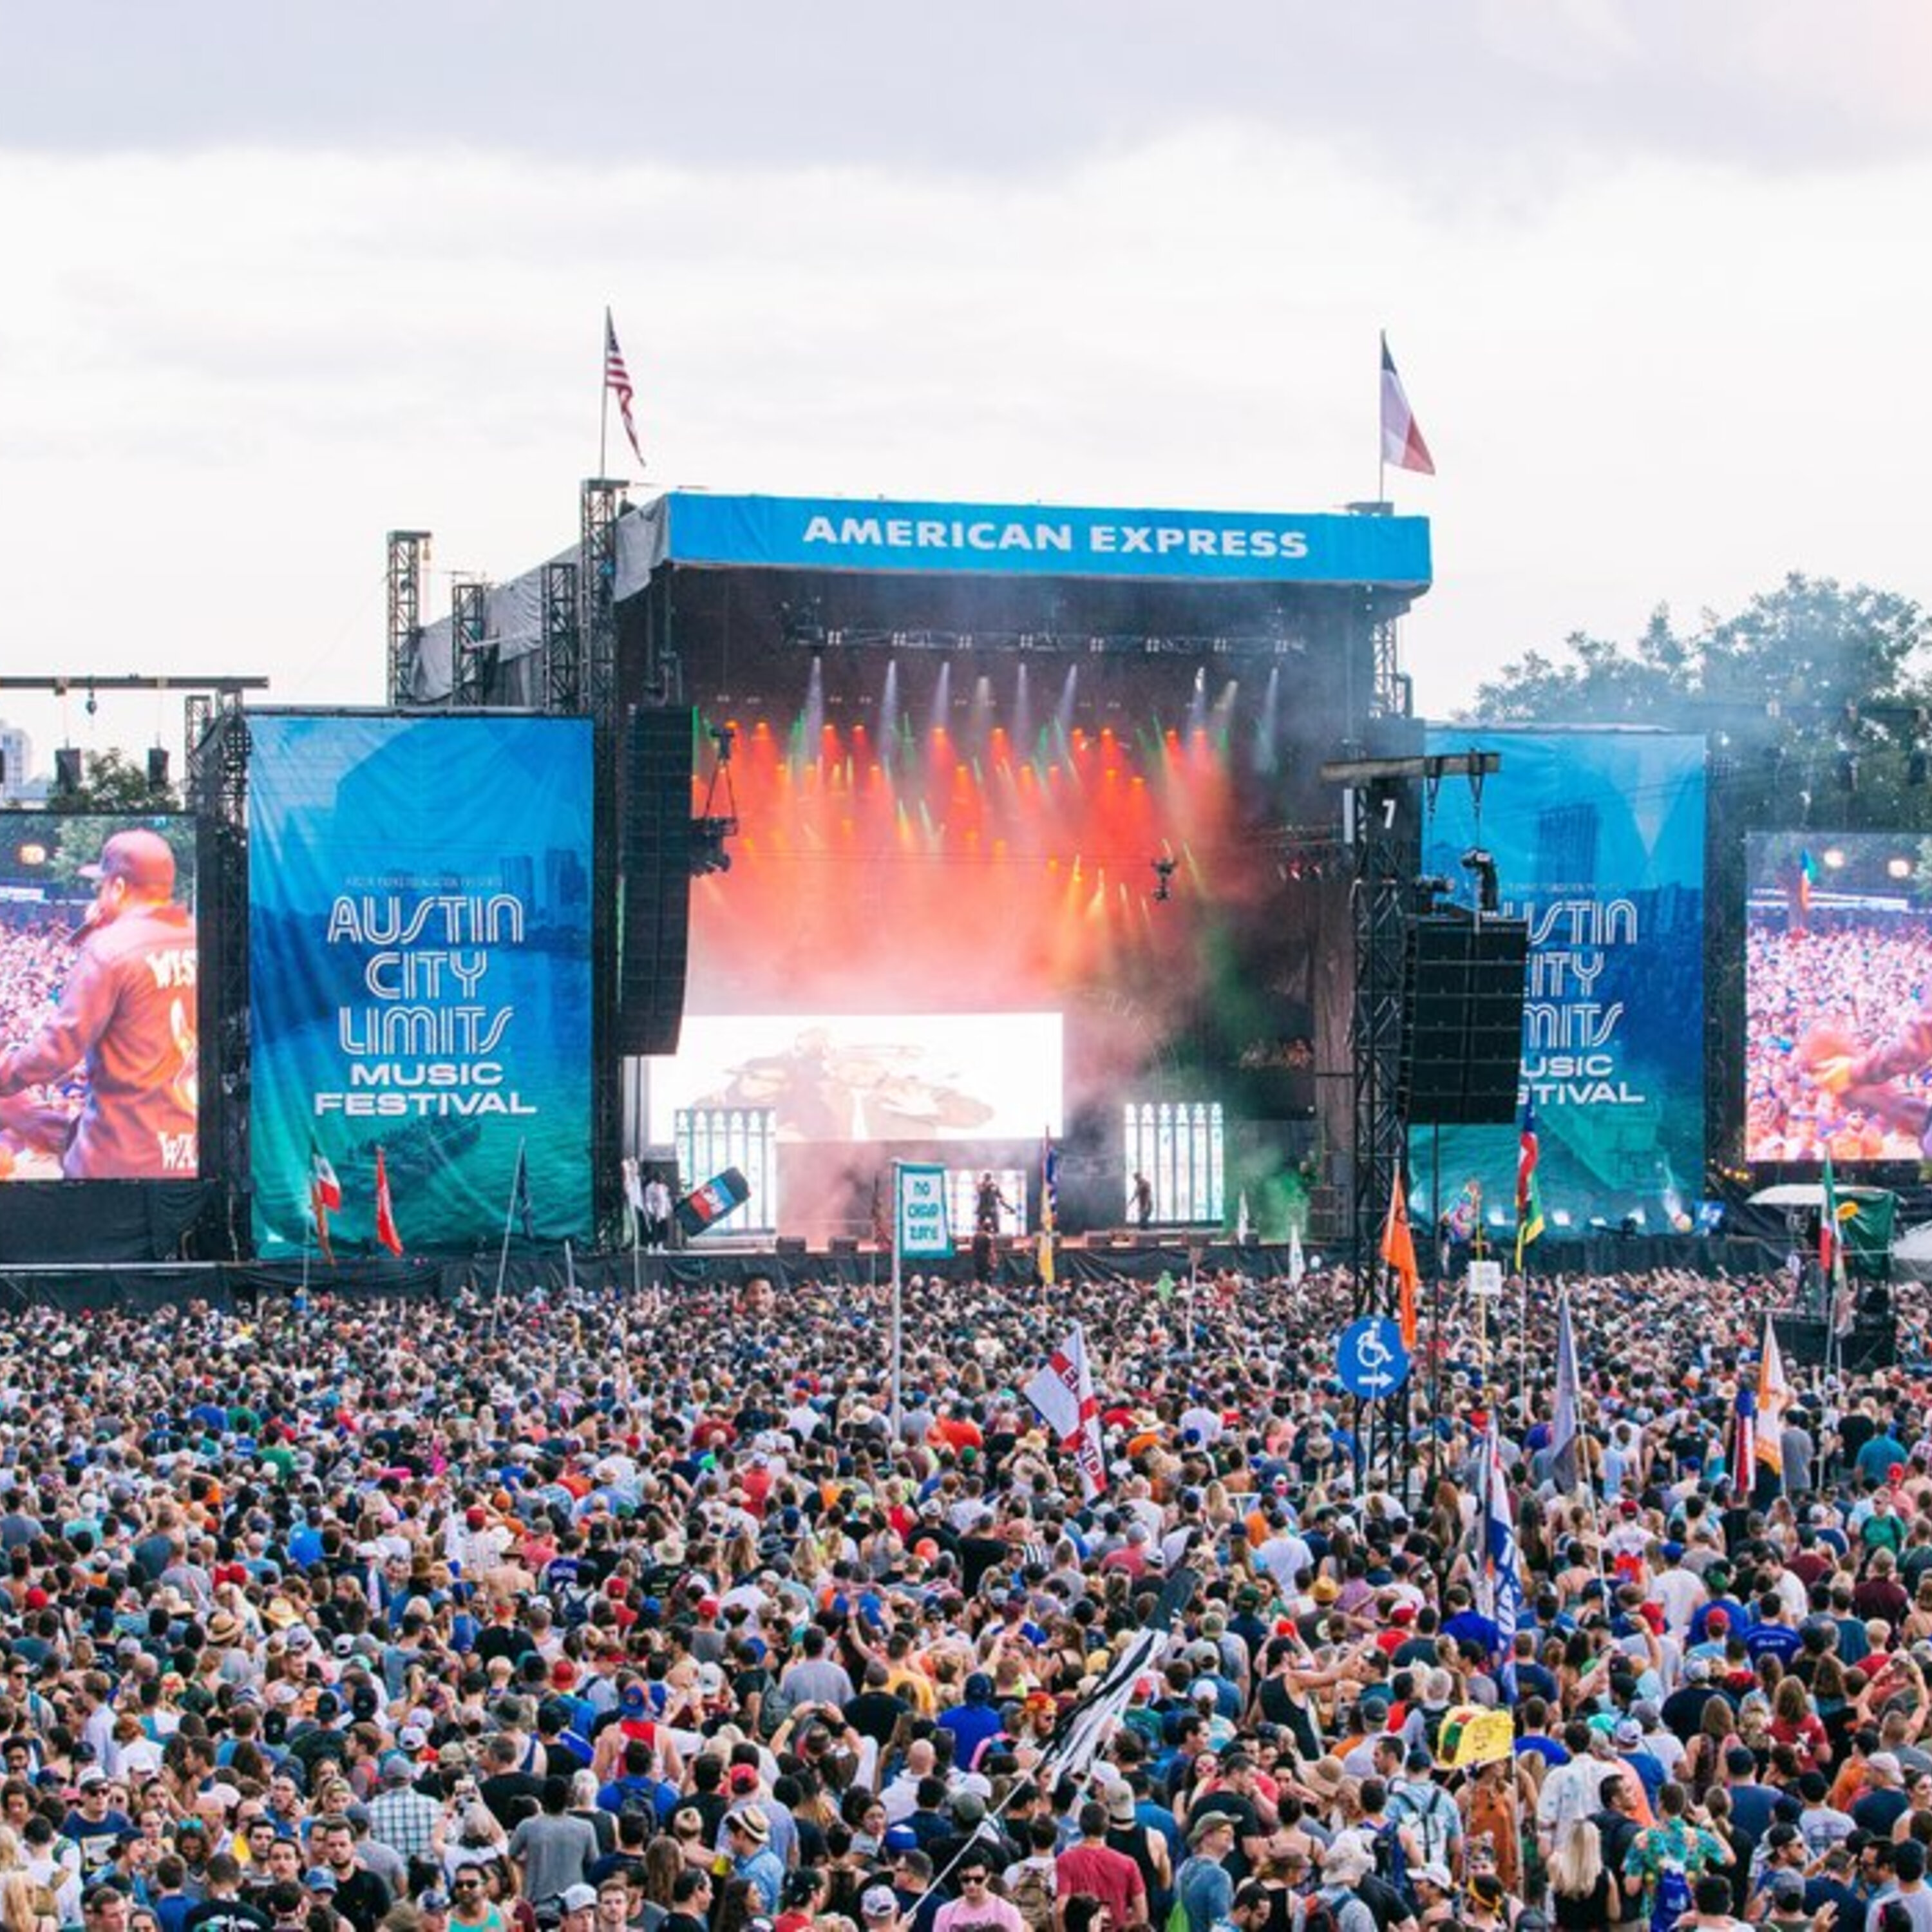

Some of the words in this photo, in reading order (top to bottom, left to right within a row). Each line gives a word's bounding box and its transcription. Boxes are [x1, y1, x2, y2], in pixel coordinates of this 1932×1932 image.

[802, 515, 1072, 551] AMERICAN
[1090, 525, 1309, 559] EXPRESS
[1382, 799, 1395, 829] 7
[327, 894, 524, 945] AUSTIN
[1503, 899, 1638, 946] STIN
[365, 951, 488, 1000] CITY
[1524, 951, 1605, 998] ITY
[339, 1006, 514, 1056] LIMITS
[1523, 1002, 1624, 1049] MITS
[350, 1062, 504, 1086] MUSIC
[1520, 1054, 1613, 1077] USIC
[314, 1092, 538, 1116] FESTIVAL
